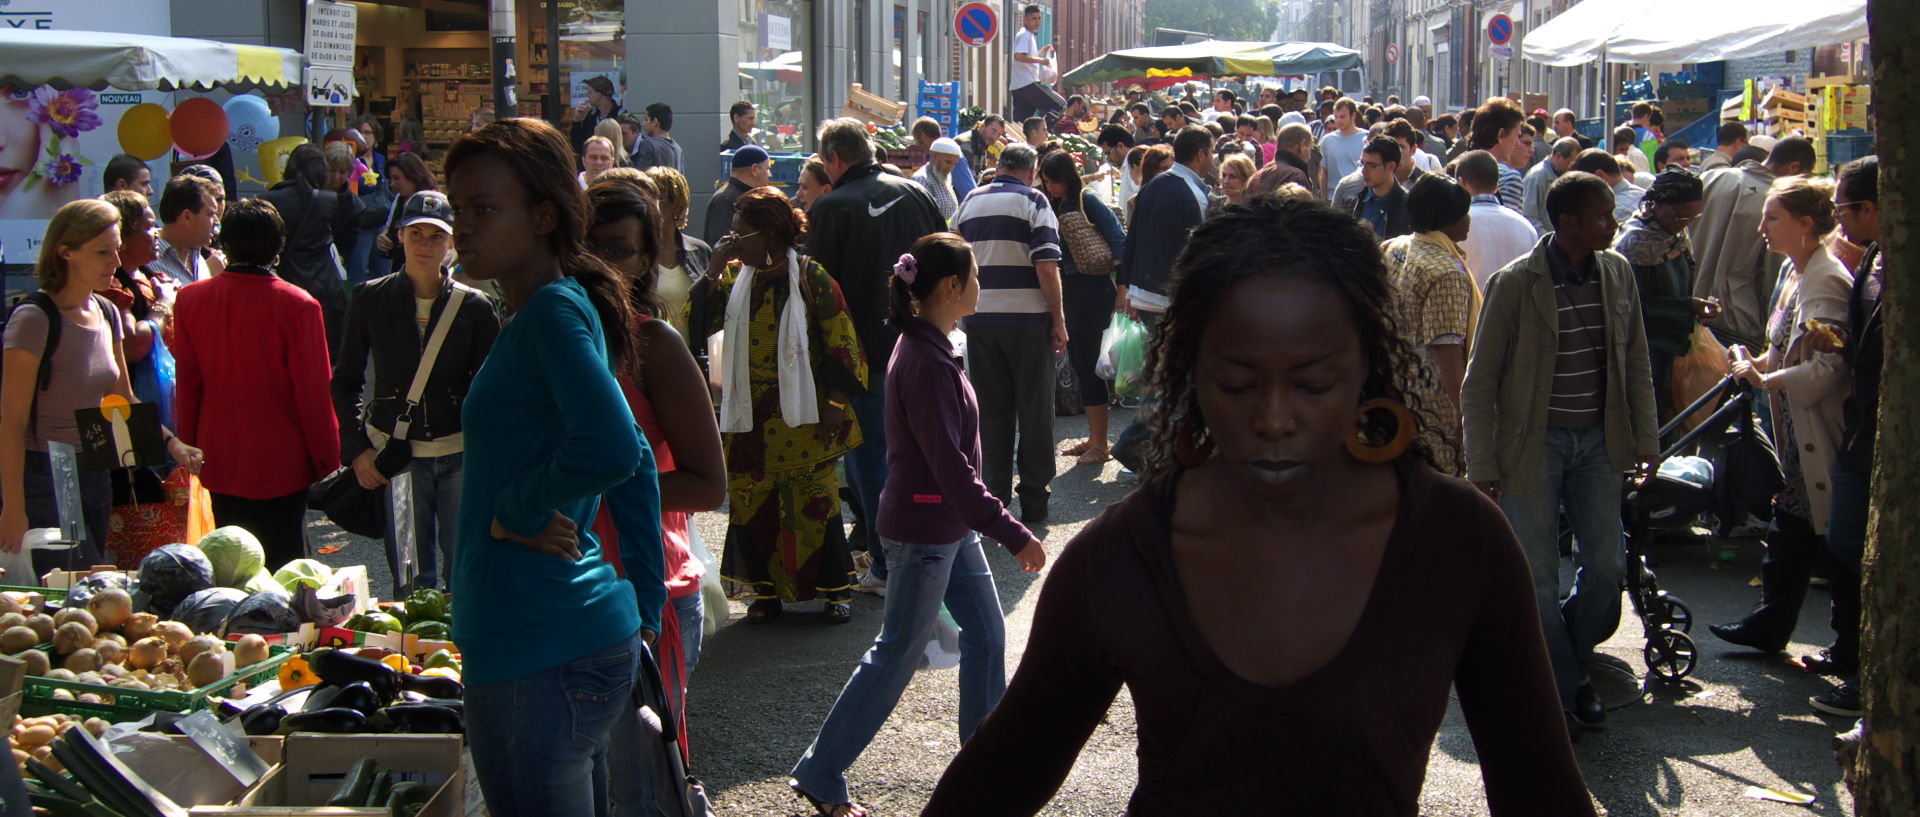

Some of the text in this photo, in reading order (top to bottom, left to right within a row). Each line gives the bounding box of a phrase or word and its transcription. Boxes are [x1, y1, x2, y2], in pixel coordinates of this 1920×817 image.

[318, 8, 341, 16] INTERDIT
[312, 19, 330, 27] MARDIS
[323, 42, 352, 50] DIMANCHES
[311, 52, 318, 60] DE
[101, 95, 141, 103] NOUVEAU
